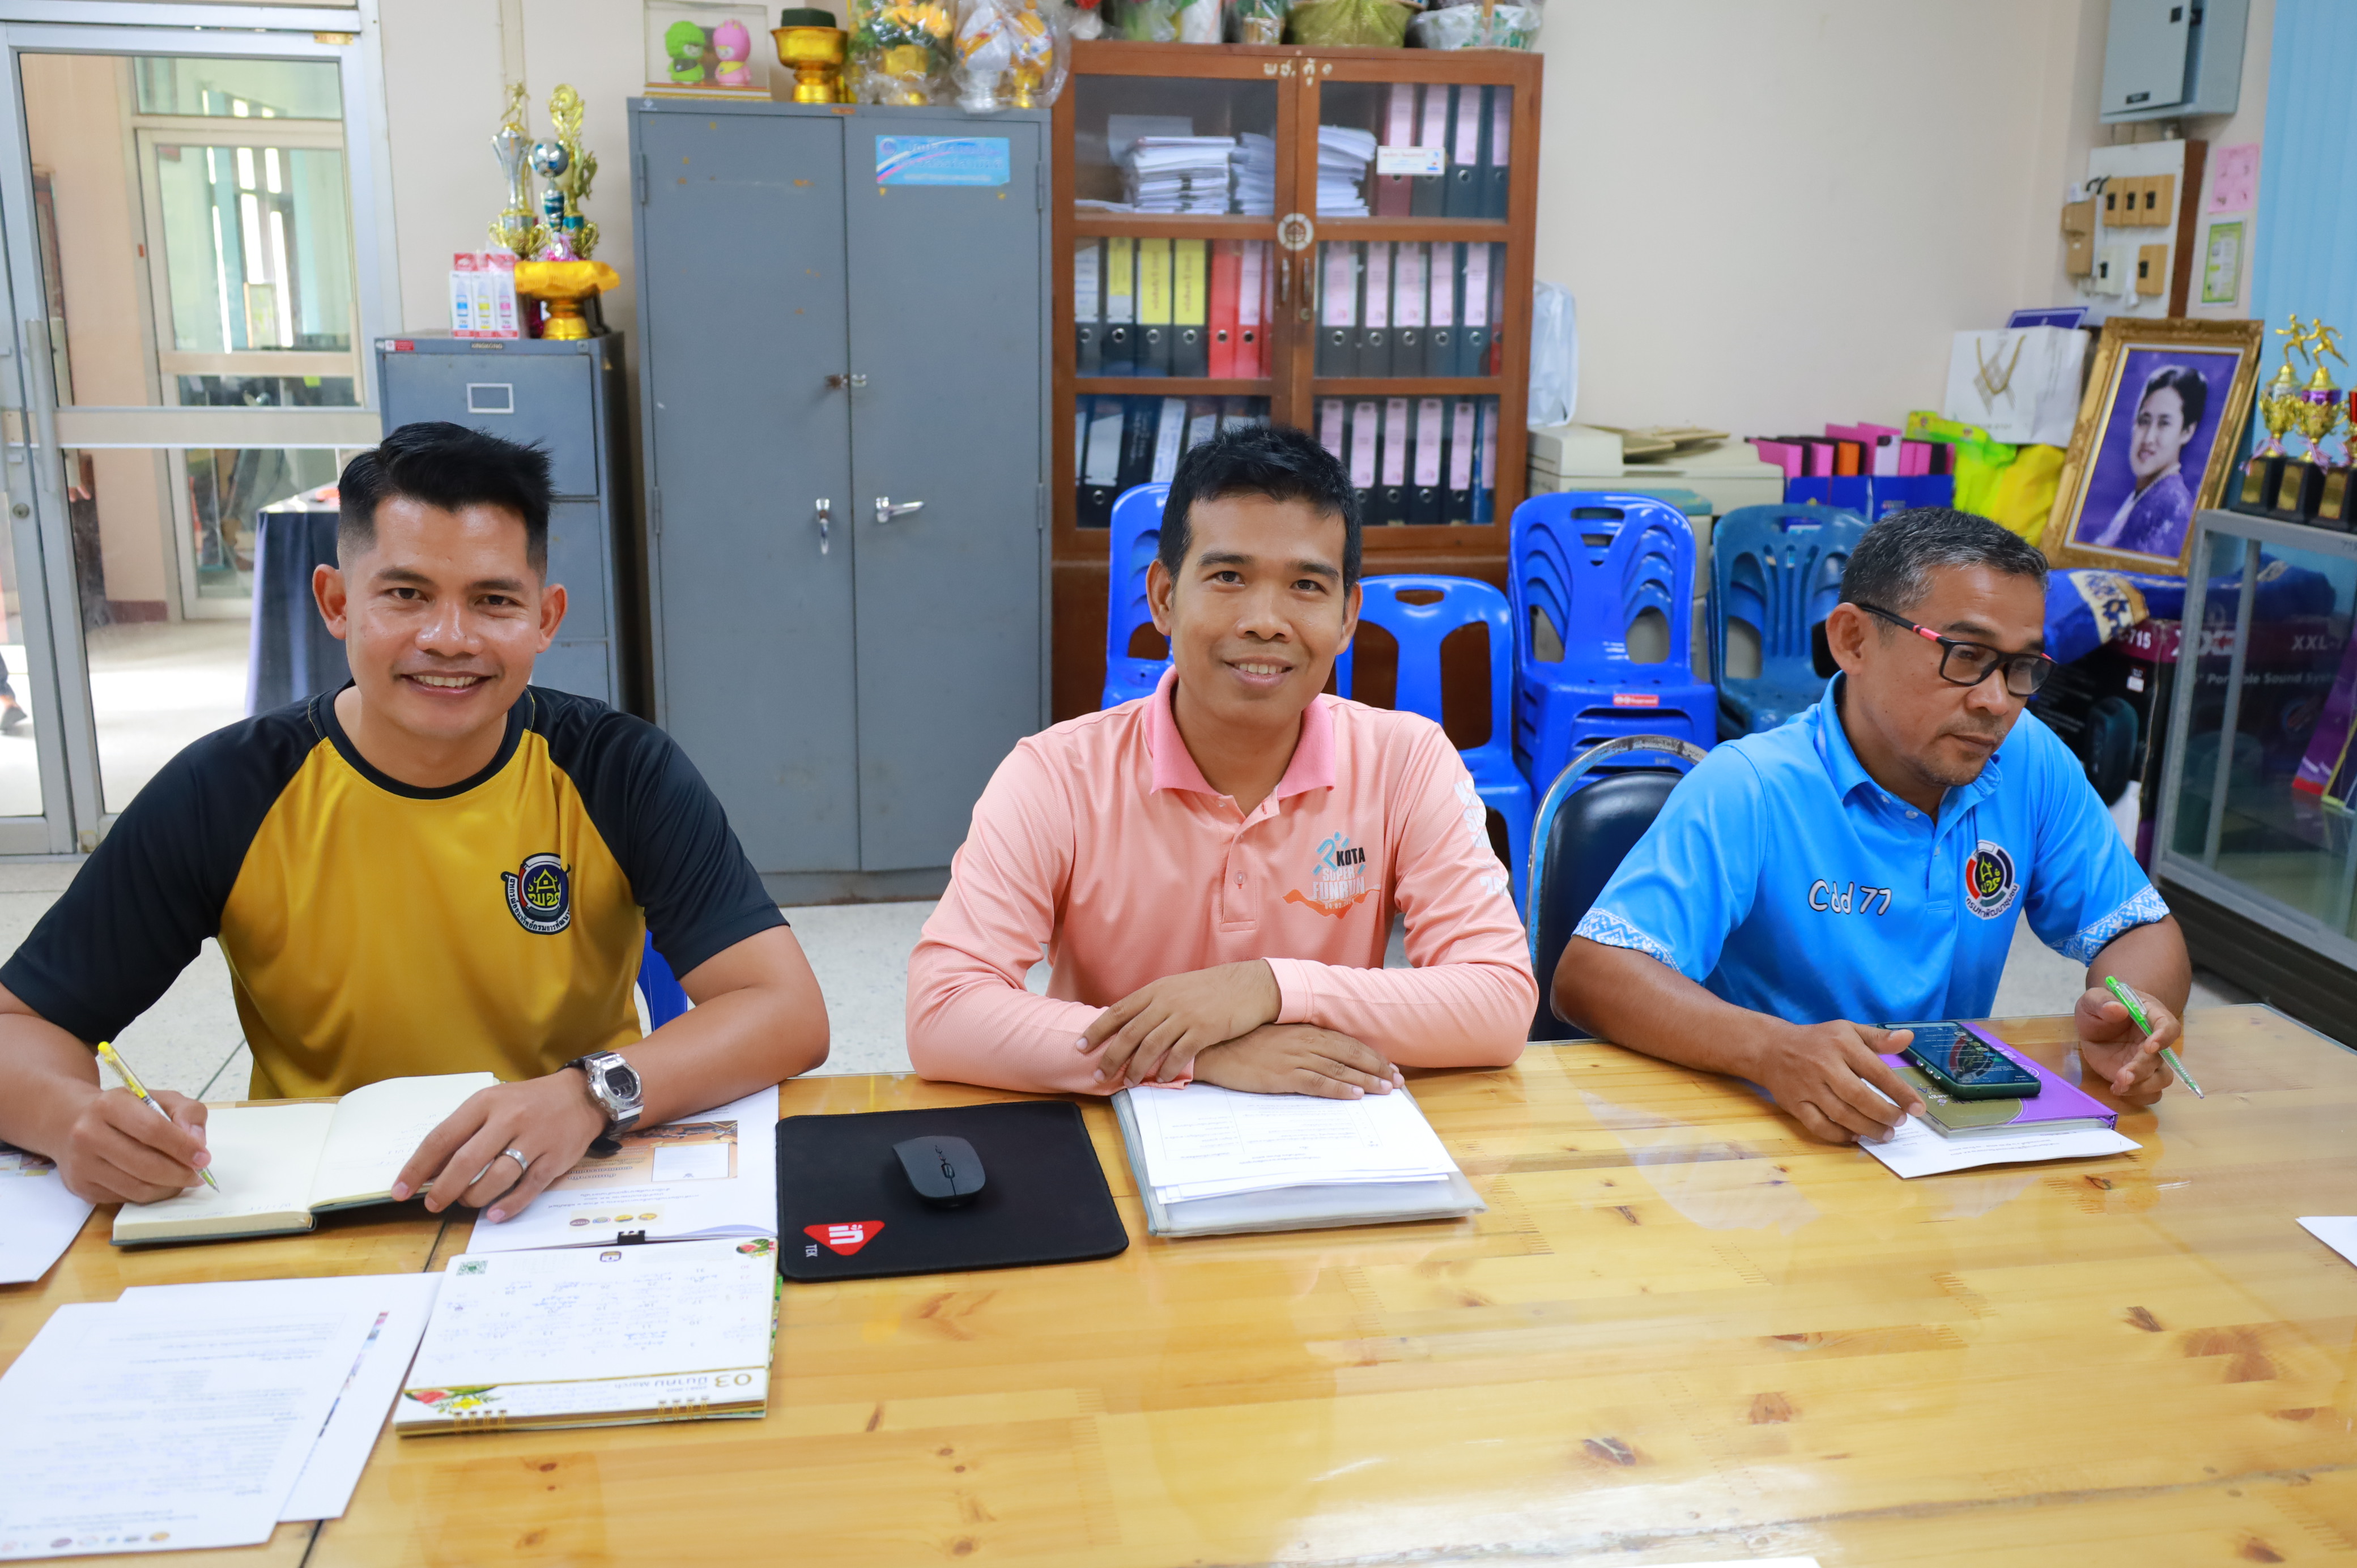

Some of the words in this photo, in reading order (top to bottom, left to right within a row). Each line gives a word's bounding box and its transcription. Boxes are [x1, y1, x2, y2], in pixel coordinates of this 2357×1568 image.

[1337, 847, 1365, 867] KOTA
[1322, 866, 1355, 881] SUPER
[1313, 876, 1365, 901] FUNRUN
[1808, 879, 1854, 914] Cdd
[1859, 886, 1892, 915] 77
[805, 1244, 818, 1257] TEK
[654, 1376, 708, 1387] มีนาคม
[714, 1374, 752, 1388] 03
